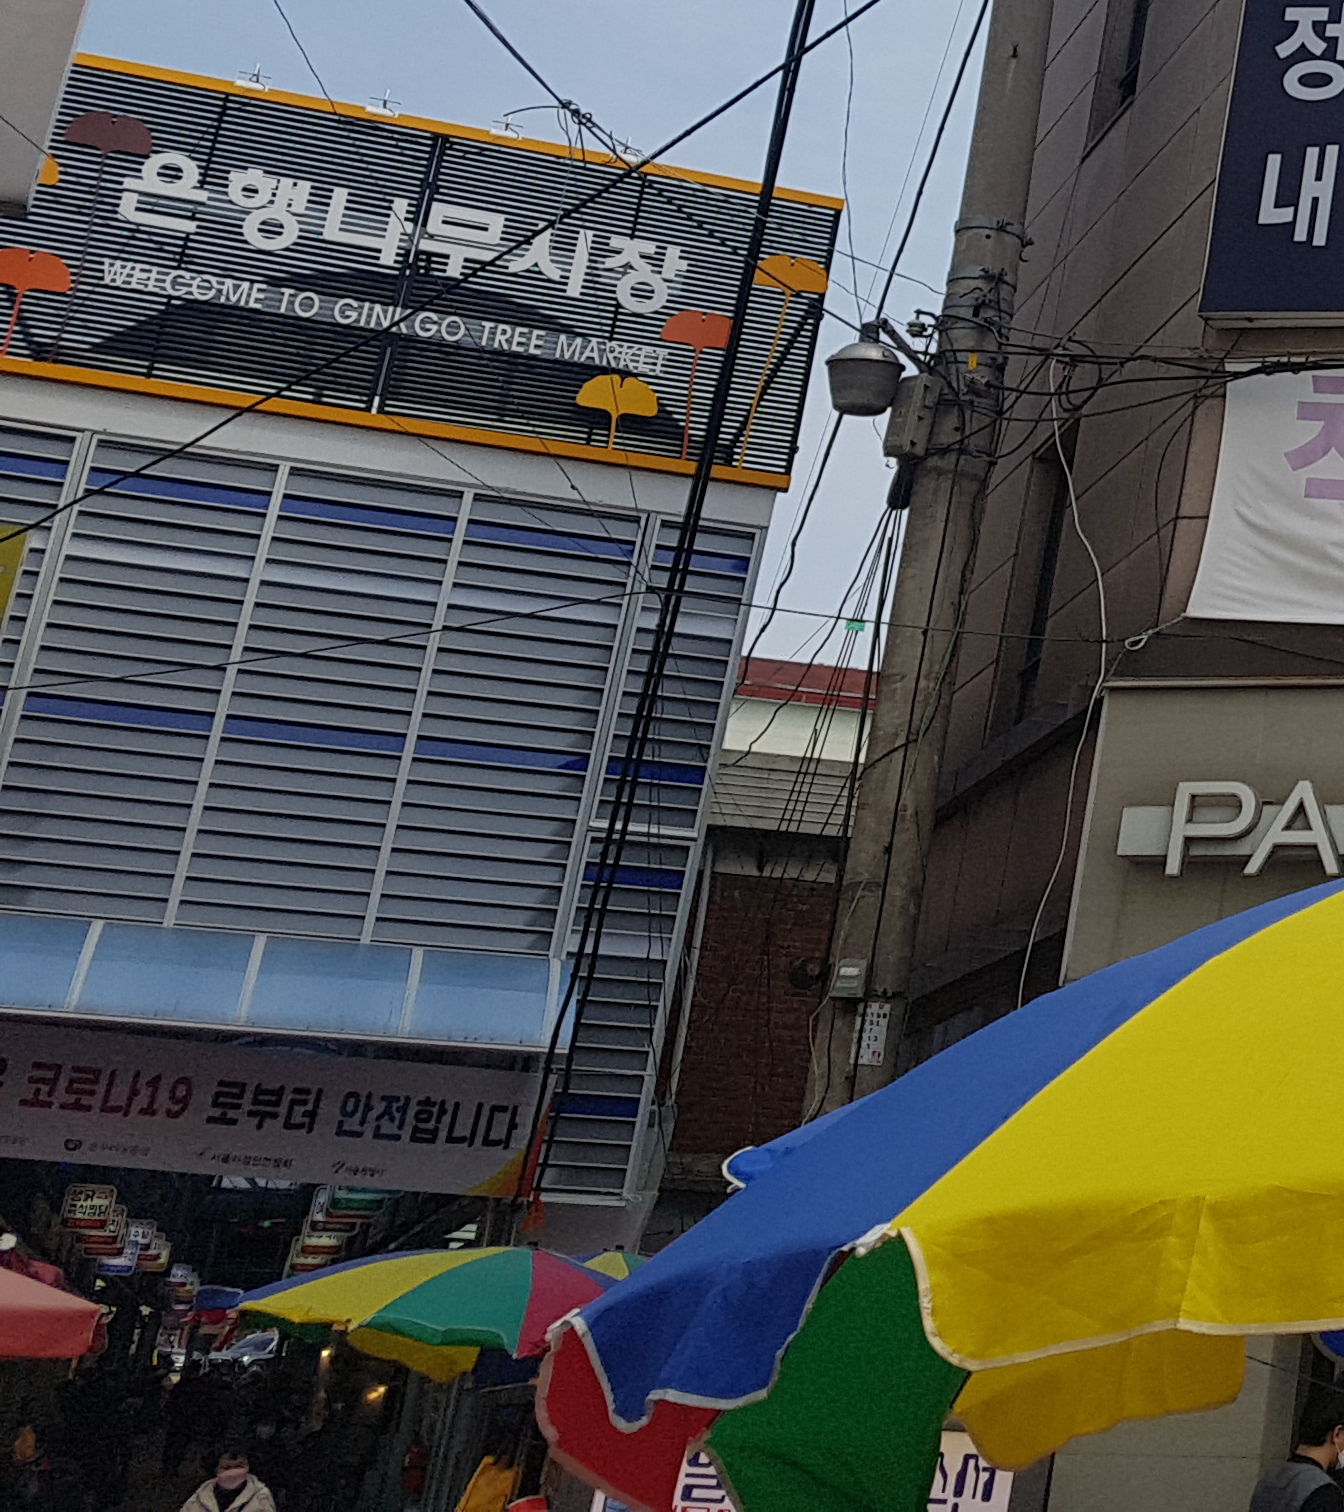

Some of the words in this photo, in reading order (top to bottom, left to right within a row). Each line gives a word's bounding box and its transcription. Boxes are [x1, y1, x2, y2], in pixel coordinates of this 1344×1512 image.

[116, 152, 689, 316] 은행나무시장
[102, 258, 268, 310] WELCOME
[275, 285, 321, 319] TO
[333, 298, 466, 343] GINKGO
[480, 320, 545, 357] TREE
[554, 332, 669, 377] MARKET
[18, 1060, 193, 1120] 코로나19
[205, 1078, 324, 1136] 로부터
[334, 1088, 519, 1150] 안전합니다
